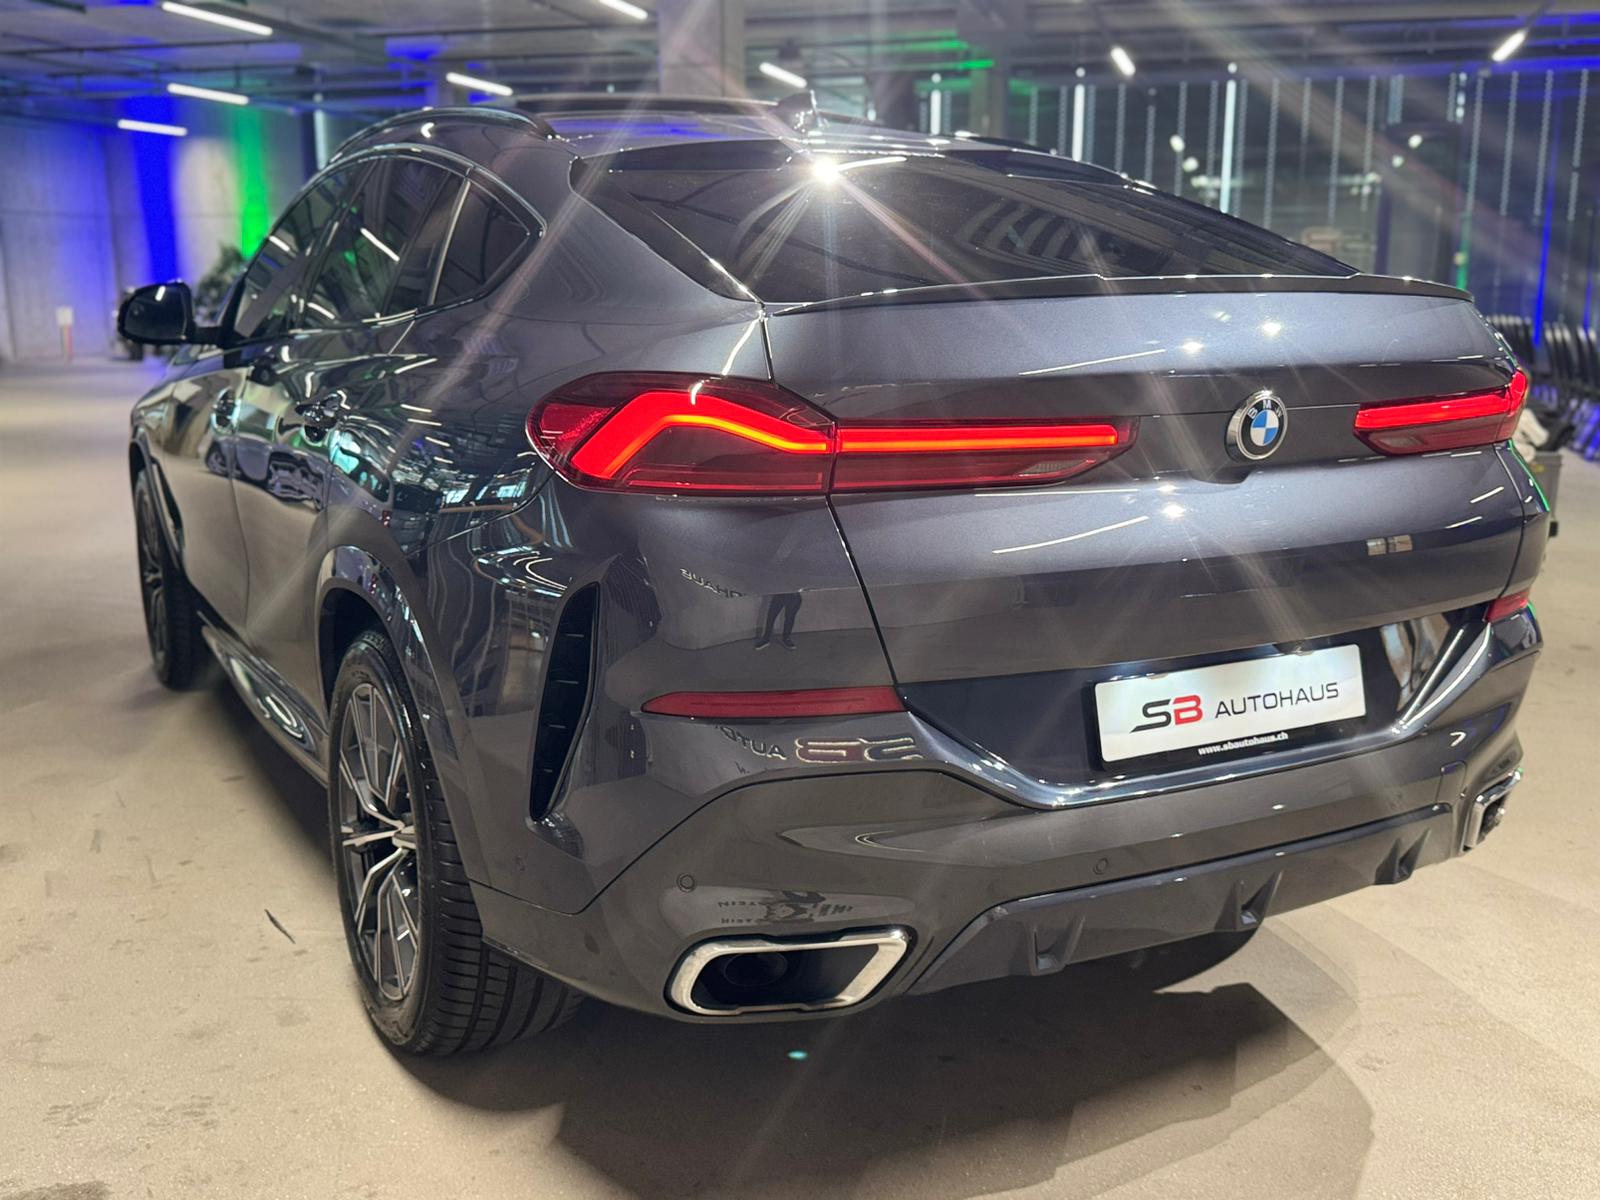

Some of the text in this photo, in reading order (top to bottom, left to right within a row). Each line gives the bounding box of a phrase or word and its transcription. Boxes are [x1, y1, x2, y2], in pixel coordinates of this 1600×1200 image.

[1246, 398, 1283, 420] BMW
[1129, 682, 1340, 733] SB AUTOHAUS
[1197, 731, 1289, 756] www.sbautohaus.ch
